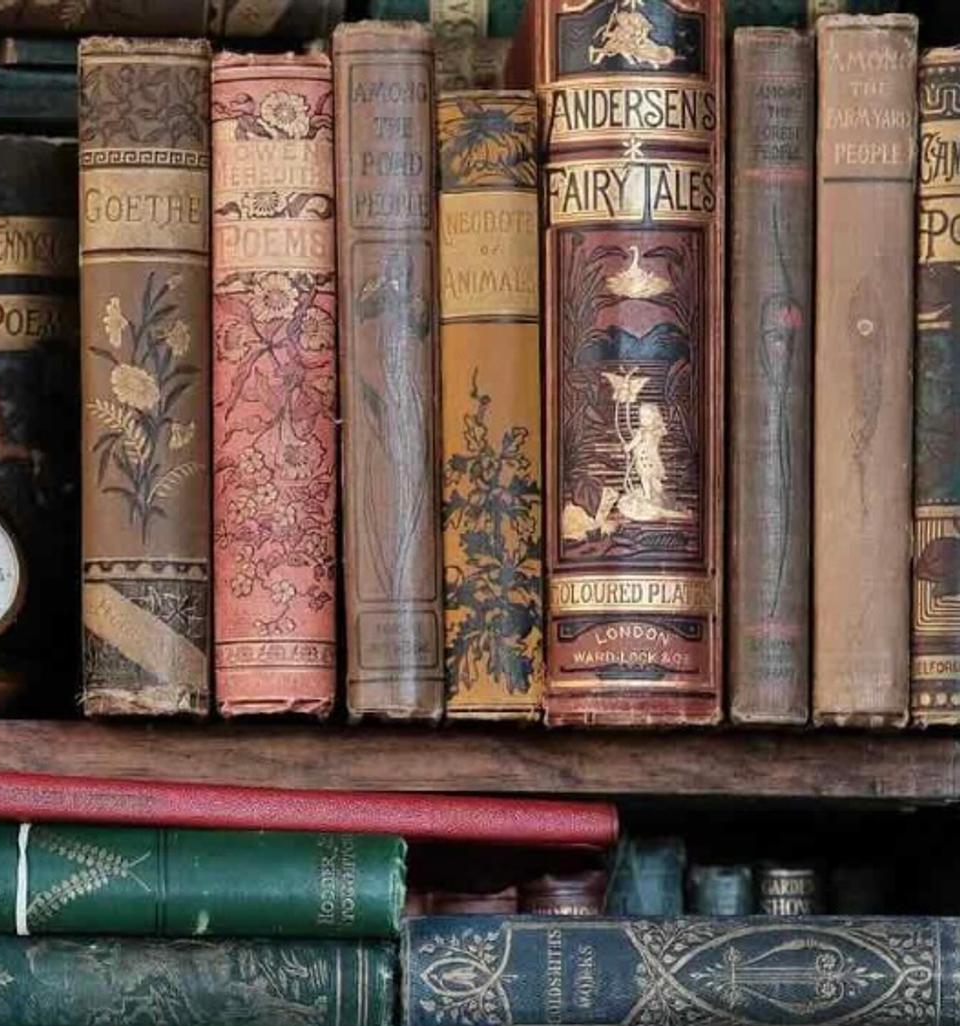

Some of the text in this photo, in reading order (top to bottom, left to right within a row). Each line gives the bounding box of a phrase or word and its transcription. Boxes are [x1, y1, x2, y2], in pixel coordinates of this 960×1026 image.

[552, 87, 717, 132] ANDERSEN'S
[833, 140, 901, 165] PEOPLE
[85, 187, 201, 229] GOETHE
[548, 162, 717, 225] FAIRY TALES
[217, 225, 325, 258] POEMS
[555, 583, 644, 606] OLOURED
[593, 623, 671, 646] LONDON
[761, 877, 813, 897] GARDE
[578, 944, 594, 1008] WORKS
